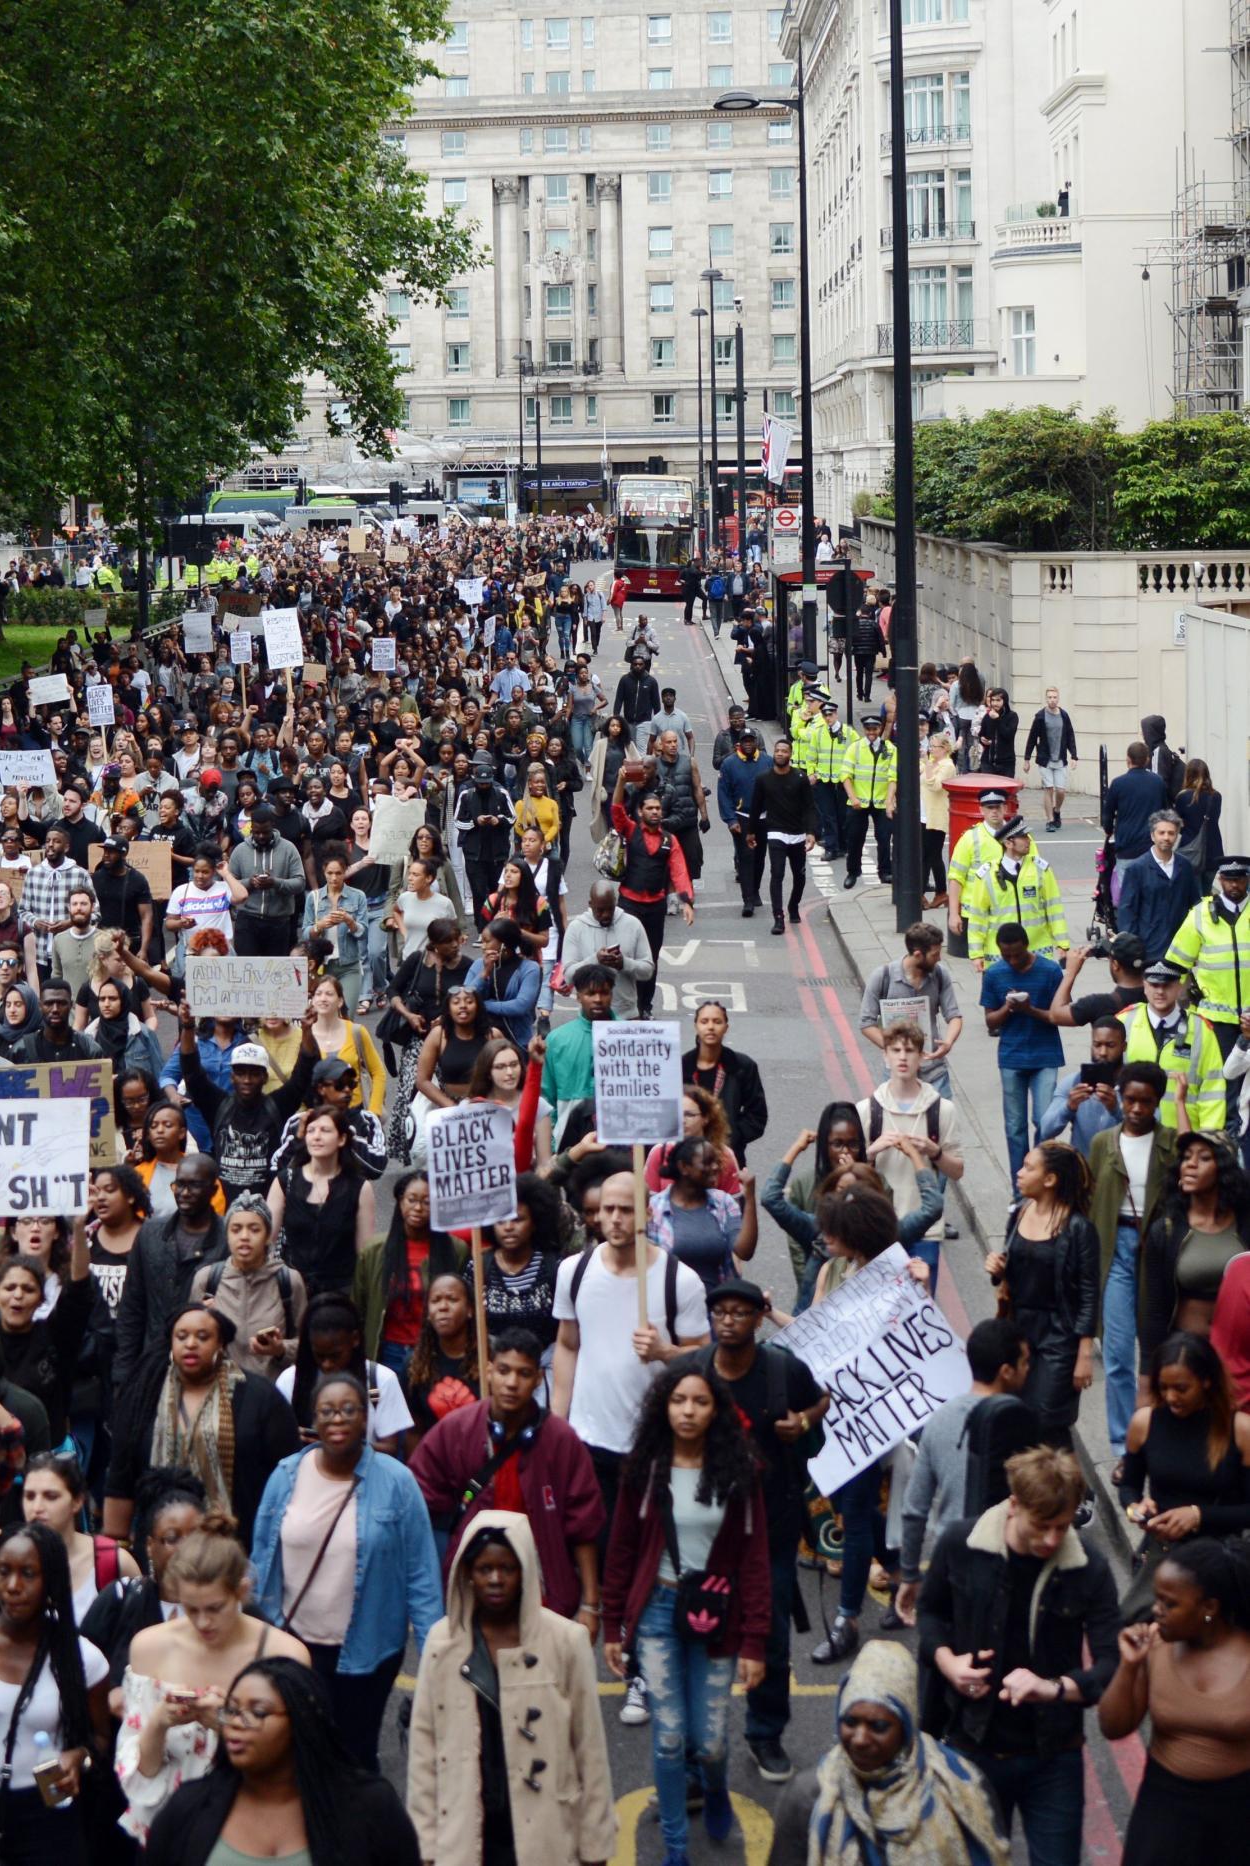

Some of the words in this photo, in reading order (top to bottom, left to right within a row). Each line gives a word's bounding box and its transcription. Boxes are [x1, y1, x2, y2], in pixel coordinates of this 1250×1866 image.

[88, 690, 107, 698] BLACK
[90, 705, 112, 714] MATTER
[183, 901, 214, 911] adidas
[599, 1039, 671, 1060] Solidarity
[599, 1060, 630, 1077] with
[637, 1060, 661, 1077] the
[49, 1065, 103, 1097] WE
[599, 1079, 661, 1097] families
[431, 1117, 494, 1148] BLACK
[433, 1145, 487, 1173] LIVES
[435, 1164, 510, 1199] MATTER
[867, 1303, 953, 1383] LIVES
[833, 1372, 948, 1467] MATTER
